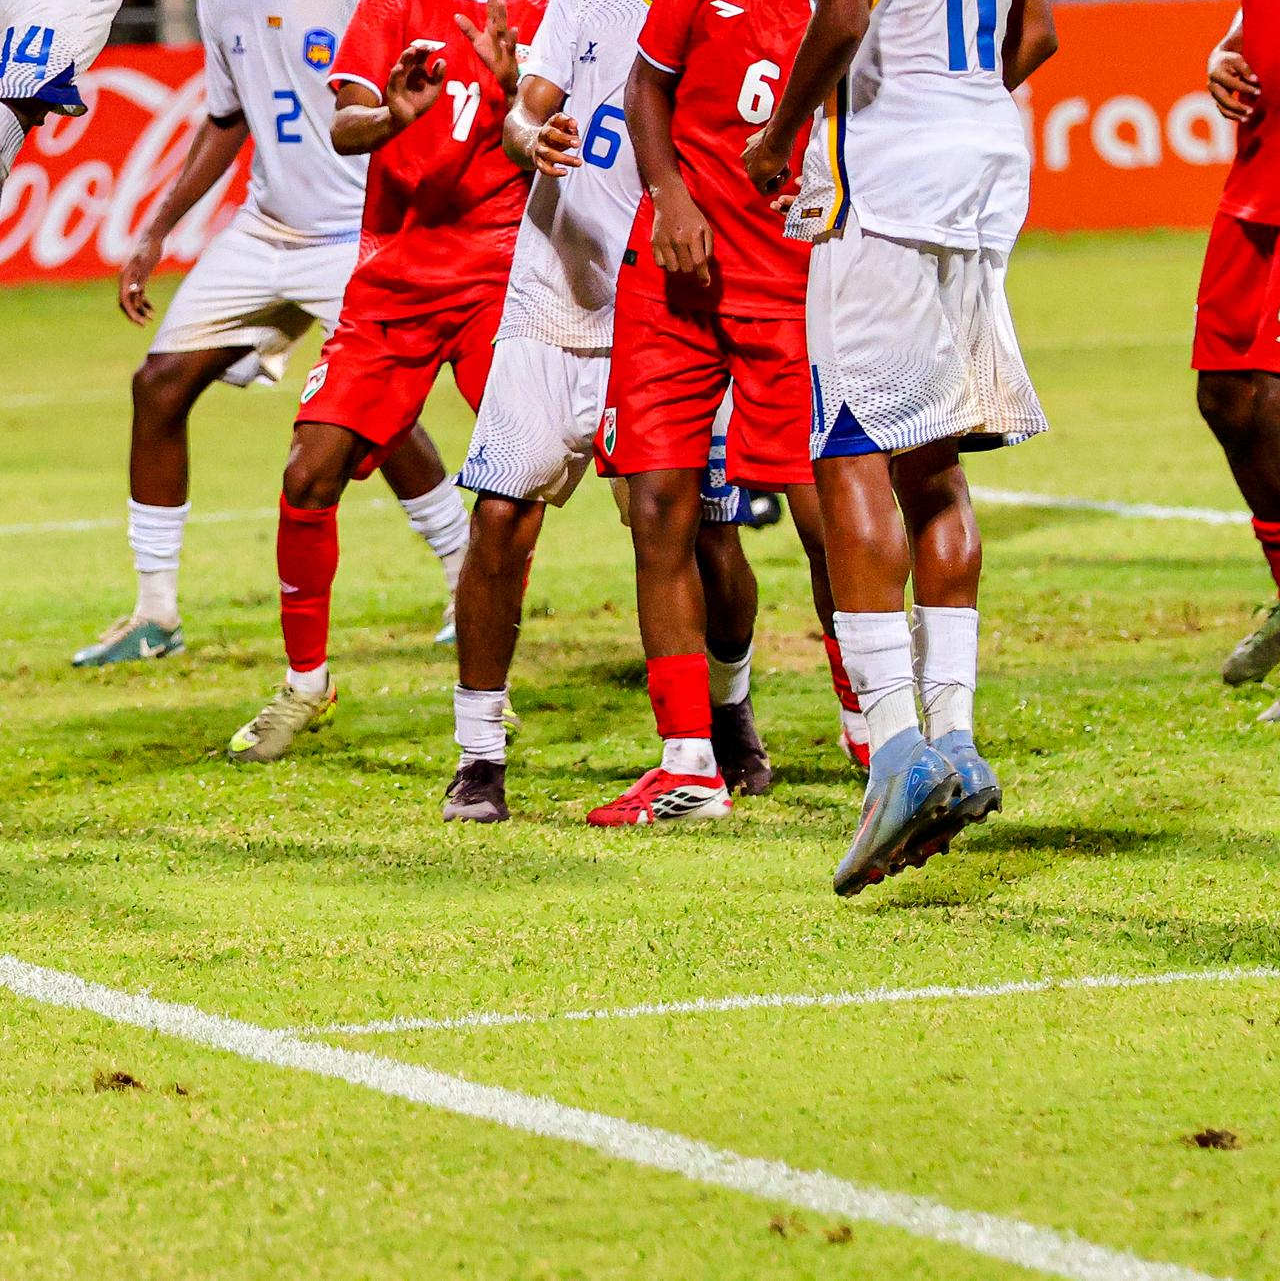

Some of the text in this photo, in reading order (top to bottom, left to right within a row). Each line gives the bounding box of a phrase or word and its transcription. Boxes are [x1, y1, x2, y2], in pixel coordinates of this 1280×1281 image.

[273, 90, 303, 143] 2
[736, 59, 780, 125] 6
[583, 104, 626, 170] 6
